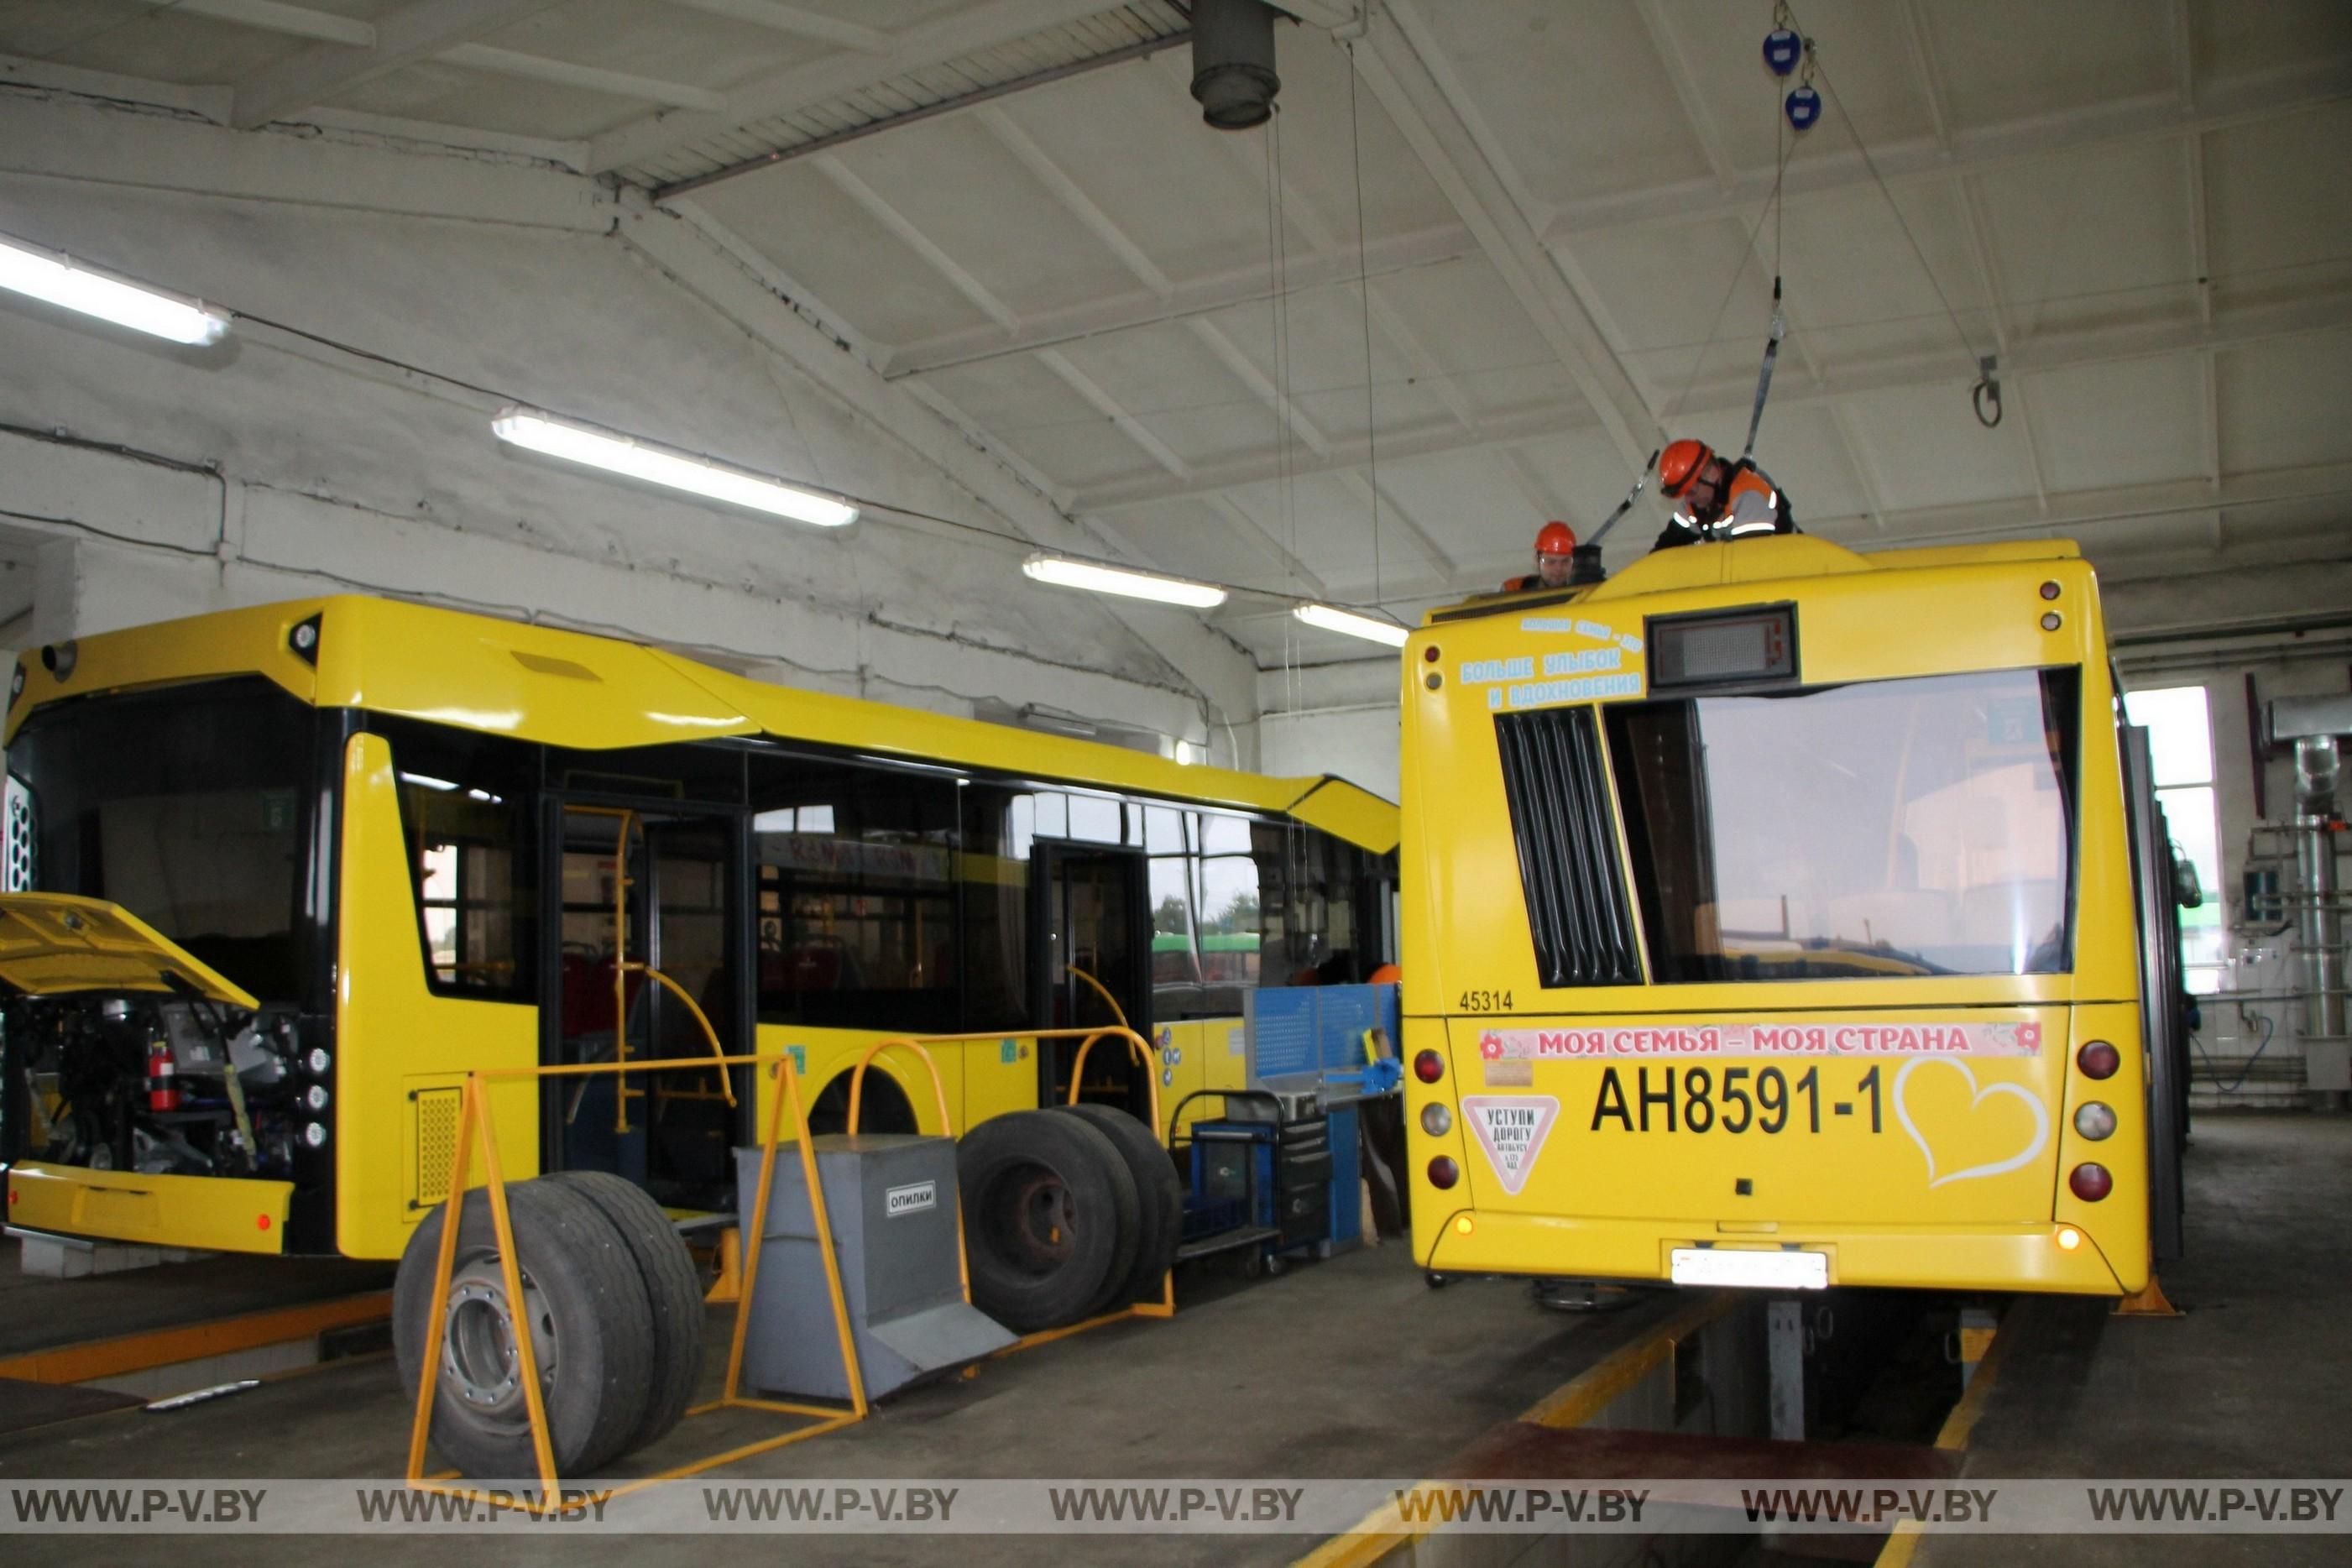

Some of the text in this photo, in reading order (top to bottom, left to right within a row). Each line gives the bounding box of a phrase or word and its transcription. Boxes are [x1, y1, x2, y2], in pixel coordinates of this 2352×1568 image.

[1461, 648, 1621, 683] БОЛЬШЕ УЛЫБОК
[1488, 672, 1641, 708] И ВДОХНОВЕНИЯ
[1460, 990, 1513, 1011] 45314
[1538, 1032, 1607, 1053] МОЯ
[1613, 1030, 1719, 1053] СЕМЬЯ
[1752, 1027, 1827, 1050] МОЯ
[1835, 1027, 1970, 1050] СТРАНА
[1487, 1109, 1534, 1126] УСТУПИ
[1493, 1127, 1531, 1142] ДОРОГУ
[891, 1190, 933, 1208] ОПИЛКИ
